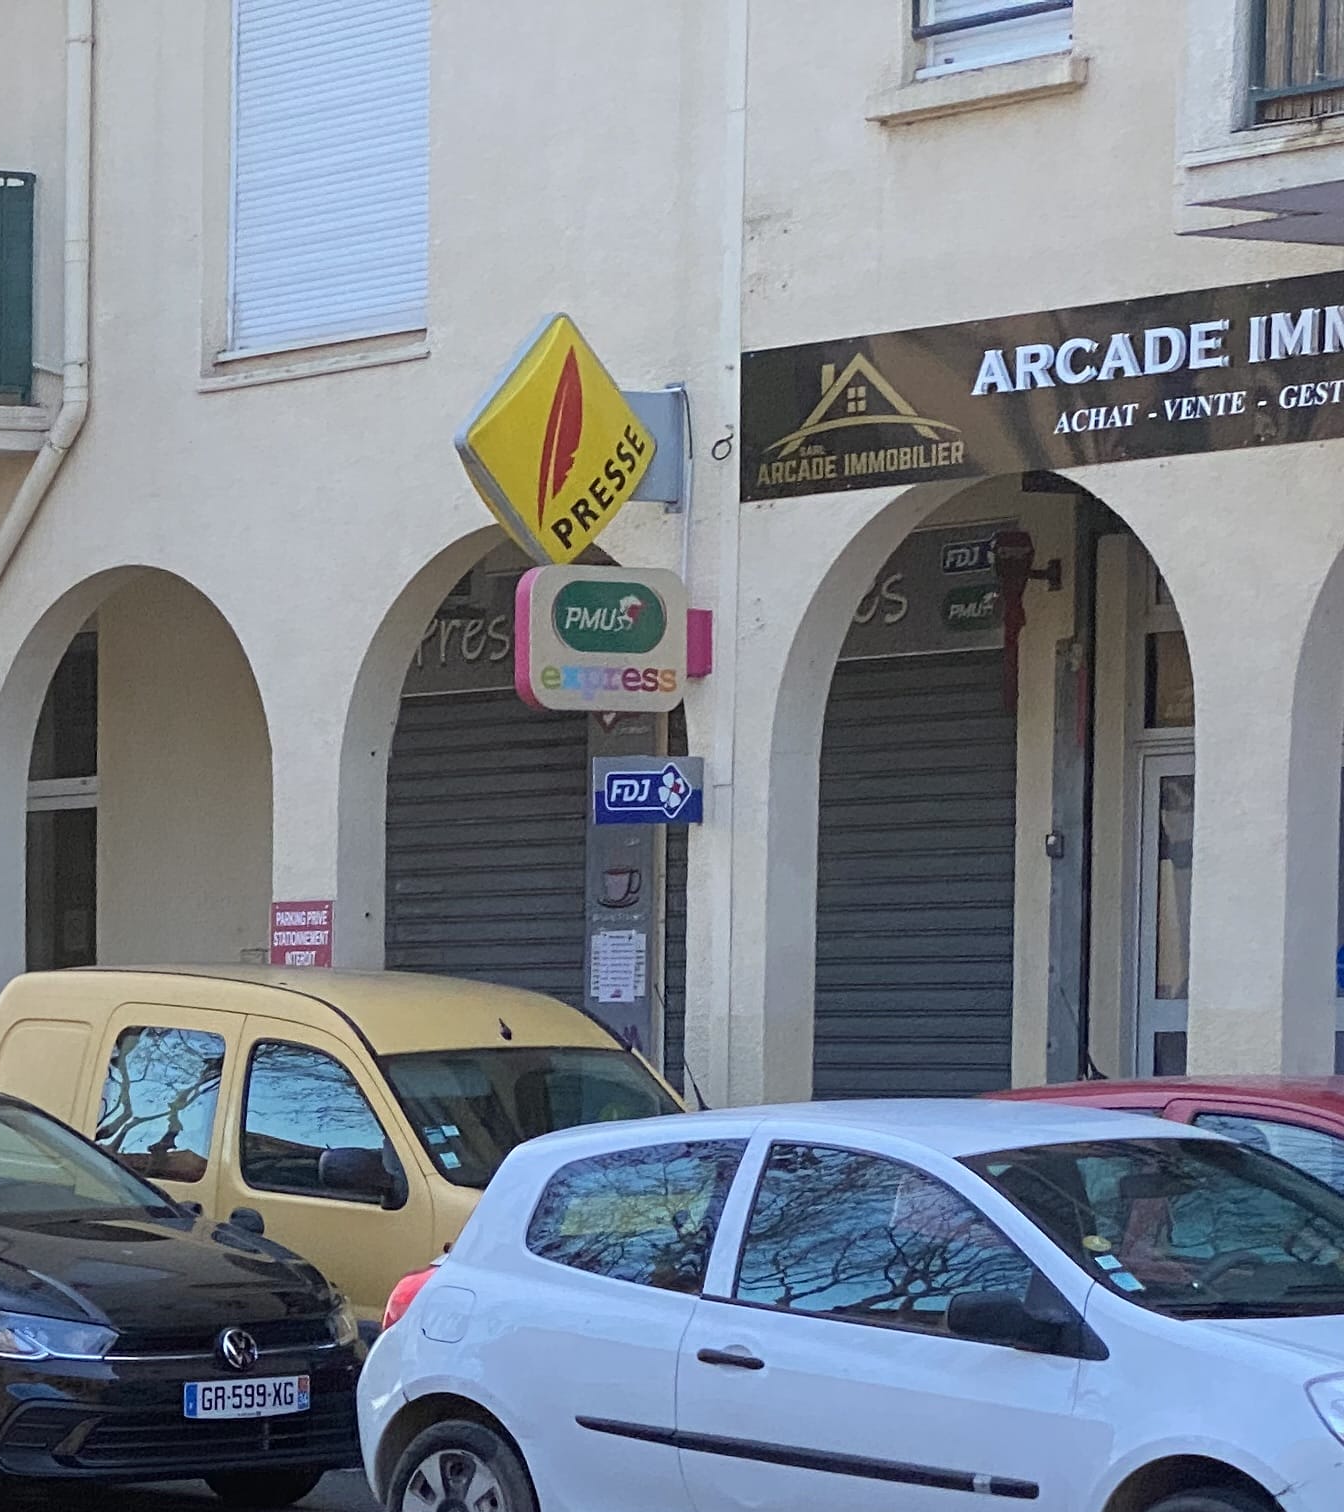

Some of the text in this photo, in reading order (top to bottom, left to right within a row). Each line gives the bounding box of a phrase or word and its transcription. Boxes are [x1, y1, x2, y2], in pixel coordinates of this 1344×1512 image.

[971, 319, 1229, 396] ARCADE
[1054, 403, 1138, 434] ACHAT
[1164, 391, 1246, 422] VENTE
[757, 441, 964, 486] ARCADE IMMOBILIER
[551, 424, 645, 550] PRESSE
[944, 546, 980, 568] FDJ
[564, 606, 614, 632] PMU
[540, 665, 677, 701] express
[610, 779, 651, 802] FDJ
[276, 911, 306, 926] PARKING
[201, 1382, 294, 1411] GR-599-XG
